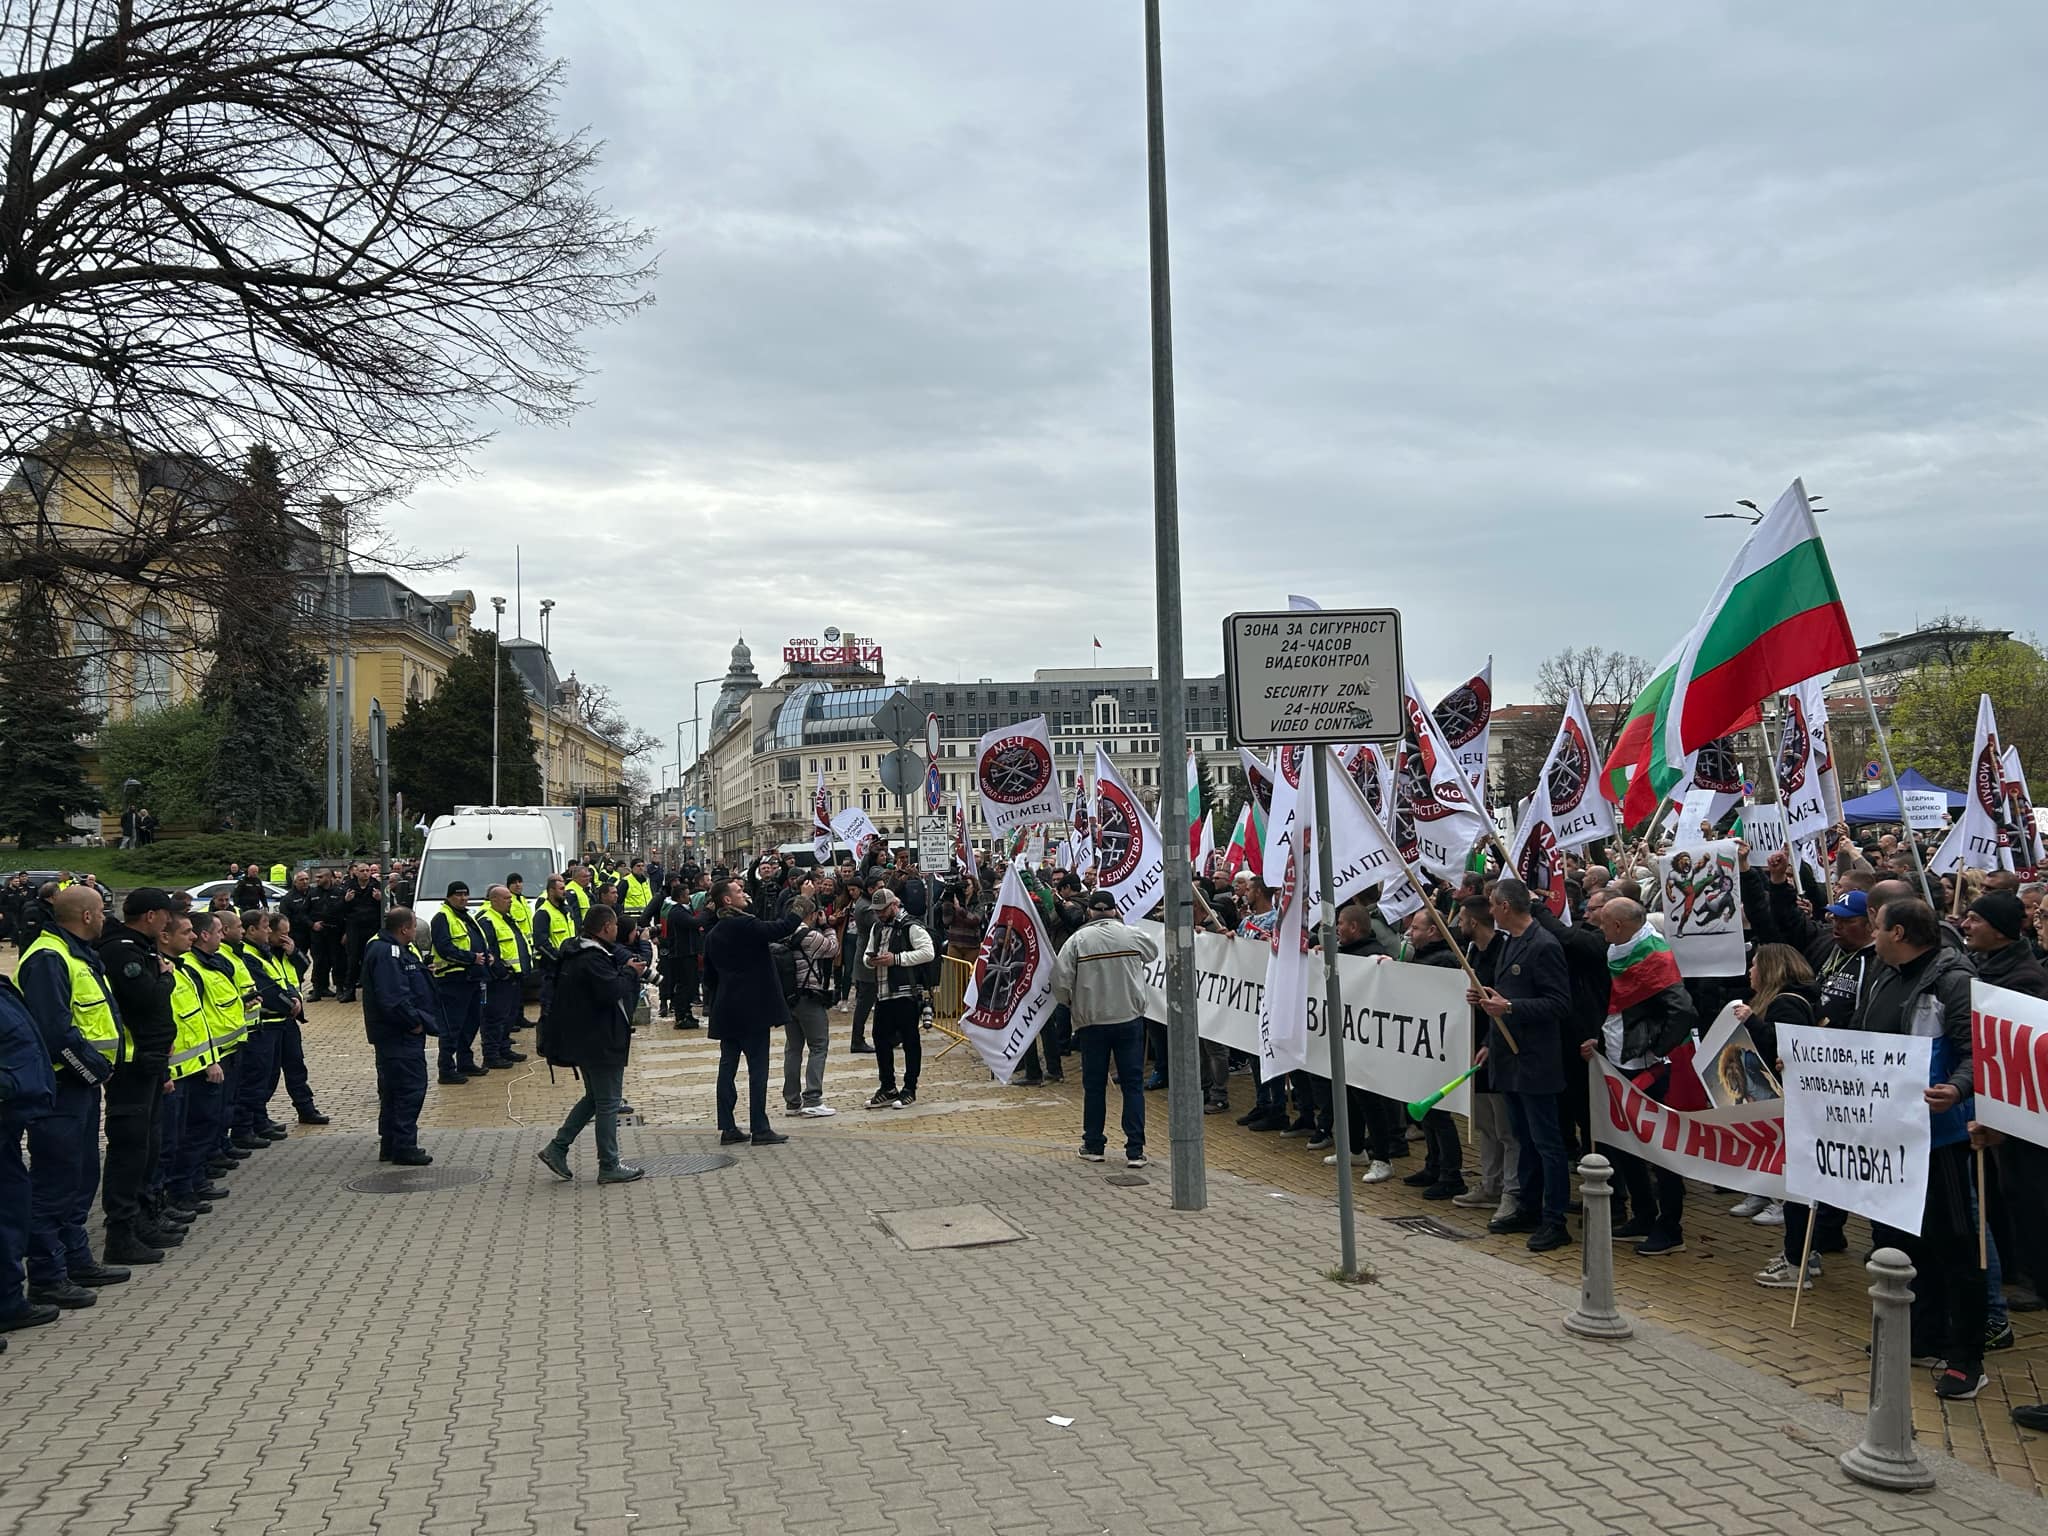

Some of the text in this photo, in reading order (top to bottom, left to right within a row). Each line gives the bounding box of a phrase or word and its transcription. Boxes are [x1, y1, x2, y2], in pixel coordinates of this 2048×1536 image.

[1244, 621, 1386, 636] ЗОНА ЗА СИГУРНОСТ
[847, 637, 876, 646] HOTEL
[1281, 639, 1351, 652] 24-ЧАСОВ
[783, 646, 882, 662] BULGARIA
[1265, 654, 1370, 670] ВИДЕОКОНТРОЛ
[1264, 684, 1329, 699] SECURITY
[1284, 701, 1355, 715] 24-HOURS
[1270, 719, 1308, 732] VIDEO
[993, 737, 1024, 754] МЕЧ
[1979, 762, 1995, 805] МОРАЛ
[996, 803, 1052, 826] ПП МЕЧ
[1788, 799, 1820, 825] МЕЧ
[1559, 813, 1597, 838] МЕЧ
[1107, 801, 1140, 882] ЕДИНСТВО ЧЕСТ
[1360, 849, 1390, 870] ПП
[1195, 969, 1265, 1015] УТРИТЕ
[1002, 1028, 1025, 1060] ПП
[1861, 1050, 1875, 1065] НЕ
[1883, 1052, 1907, 1066] МИ
[1800, 1076, 1890, 1098] ЗАПОВЯДВАЙ ДА
[1826, 1103, 1873, 1123] МЪЛЧА!
